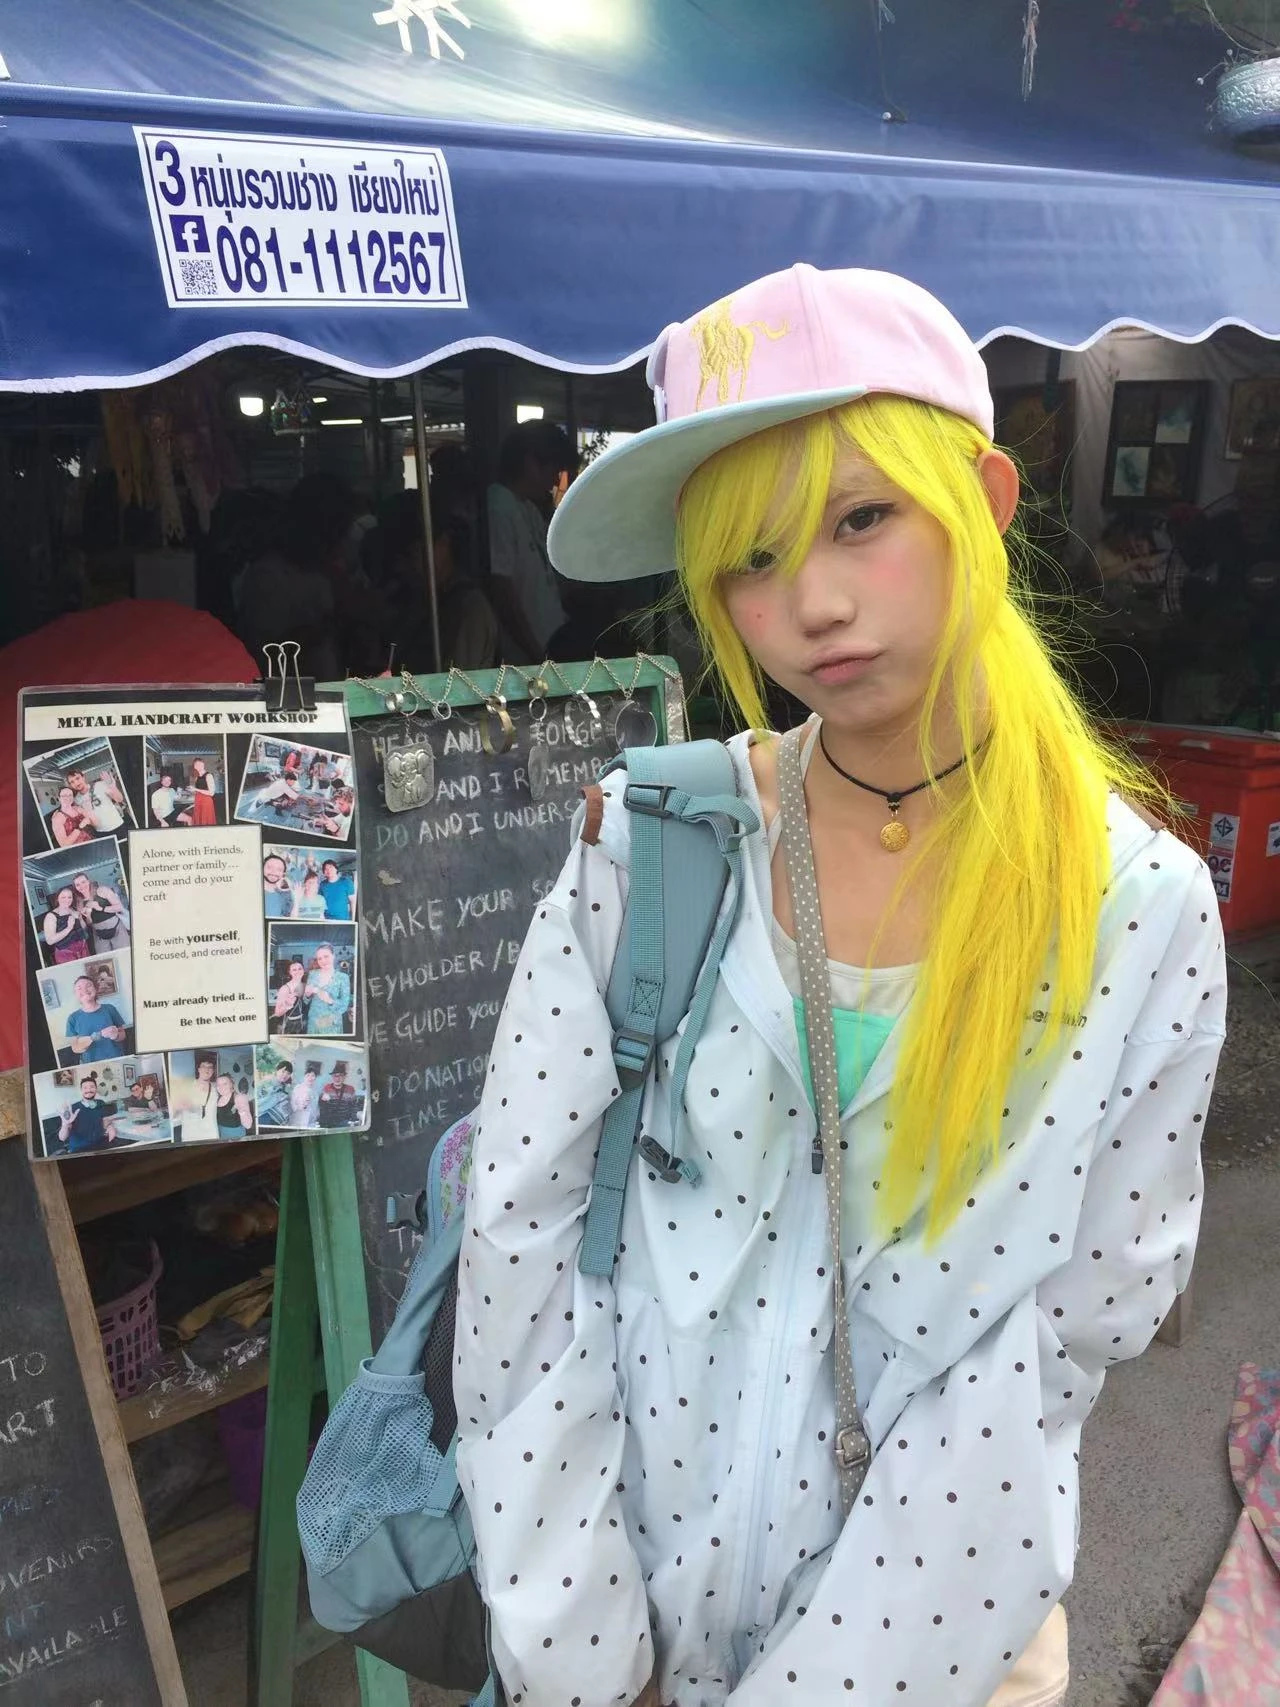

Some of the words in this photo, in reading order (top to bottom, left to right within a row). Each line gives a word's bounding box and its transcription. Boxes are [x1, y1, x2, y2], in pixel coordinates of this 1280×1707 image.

[154, 140, 187, 207] 3
[190, 153, 338, 223] หนุ่มรวมช่าง
[348, 158, 440, 217] เชียงใหม่
[216, 225, 447, 295] 081-1112567
[57, 716, 116, 729] METAL
[121, 713, 223, 727] HANDCRAFT
[227, 712, 320, 725] WORKSHOP
[435, 774, 482, 805] AND
[418, 813, 463, 844] AND
[142, 848, 176, 860] Alone,
[179, 846, 201, 856] with
[203, 844, 244, 856] Friends,
[142, 862, 180, 874] partner
[182, 862, 193, 870] or
[142, 878, 173, 888] come
[174, 875, 193, 885] and
[195, 874, 208, 884] do
[210, 874, 234, 886] your
[143, 891, 167, 903] craft
[362, 898, 443, 949] MAKE
[456, 887, 516, 929] YOUR
[149, 938, 161, 947] Be
[164, 935, 185, 945] with
[186, 930, 241, 946] yourself,
[150, 950, 190, 961] focused,
[191, 948, 209, 958] and
[210, 945, 243, 956] create!
[143, 999, 170, 1010] Many
[172, 997, 210, 1008] already
[212, 994, 236, 1004] tried
[180, 1018, 193, 1027] Be
[196, 1016, 212, 1026] the
[214, 1014, 237, 1024] Next
[239, 1013, 257, 1023] one
[395, 1003, 458, 1041] GUIDE
